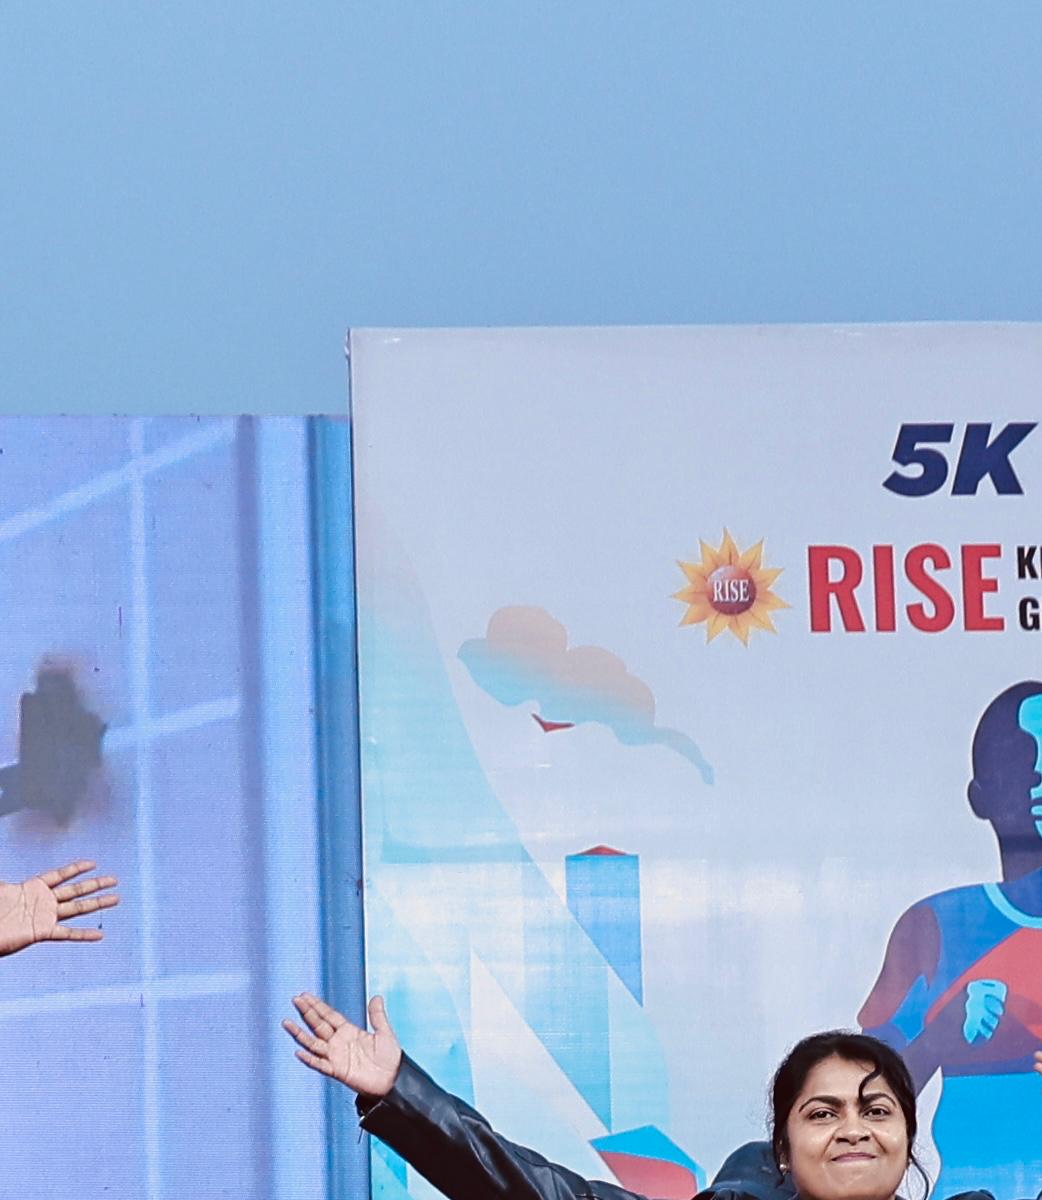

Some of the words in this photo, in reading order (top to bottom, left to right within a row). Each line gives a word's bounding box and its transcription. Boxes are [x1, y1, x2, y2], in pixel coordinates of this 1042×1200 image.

[881, 422, 1039, 497] 5K
[713, 579, 750, 602] RISE
[807, 543, 1005, 633] RISE
